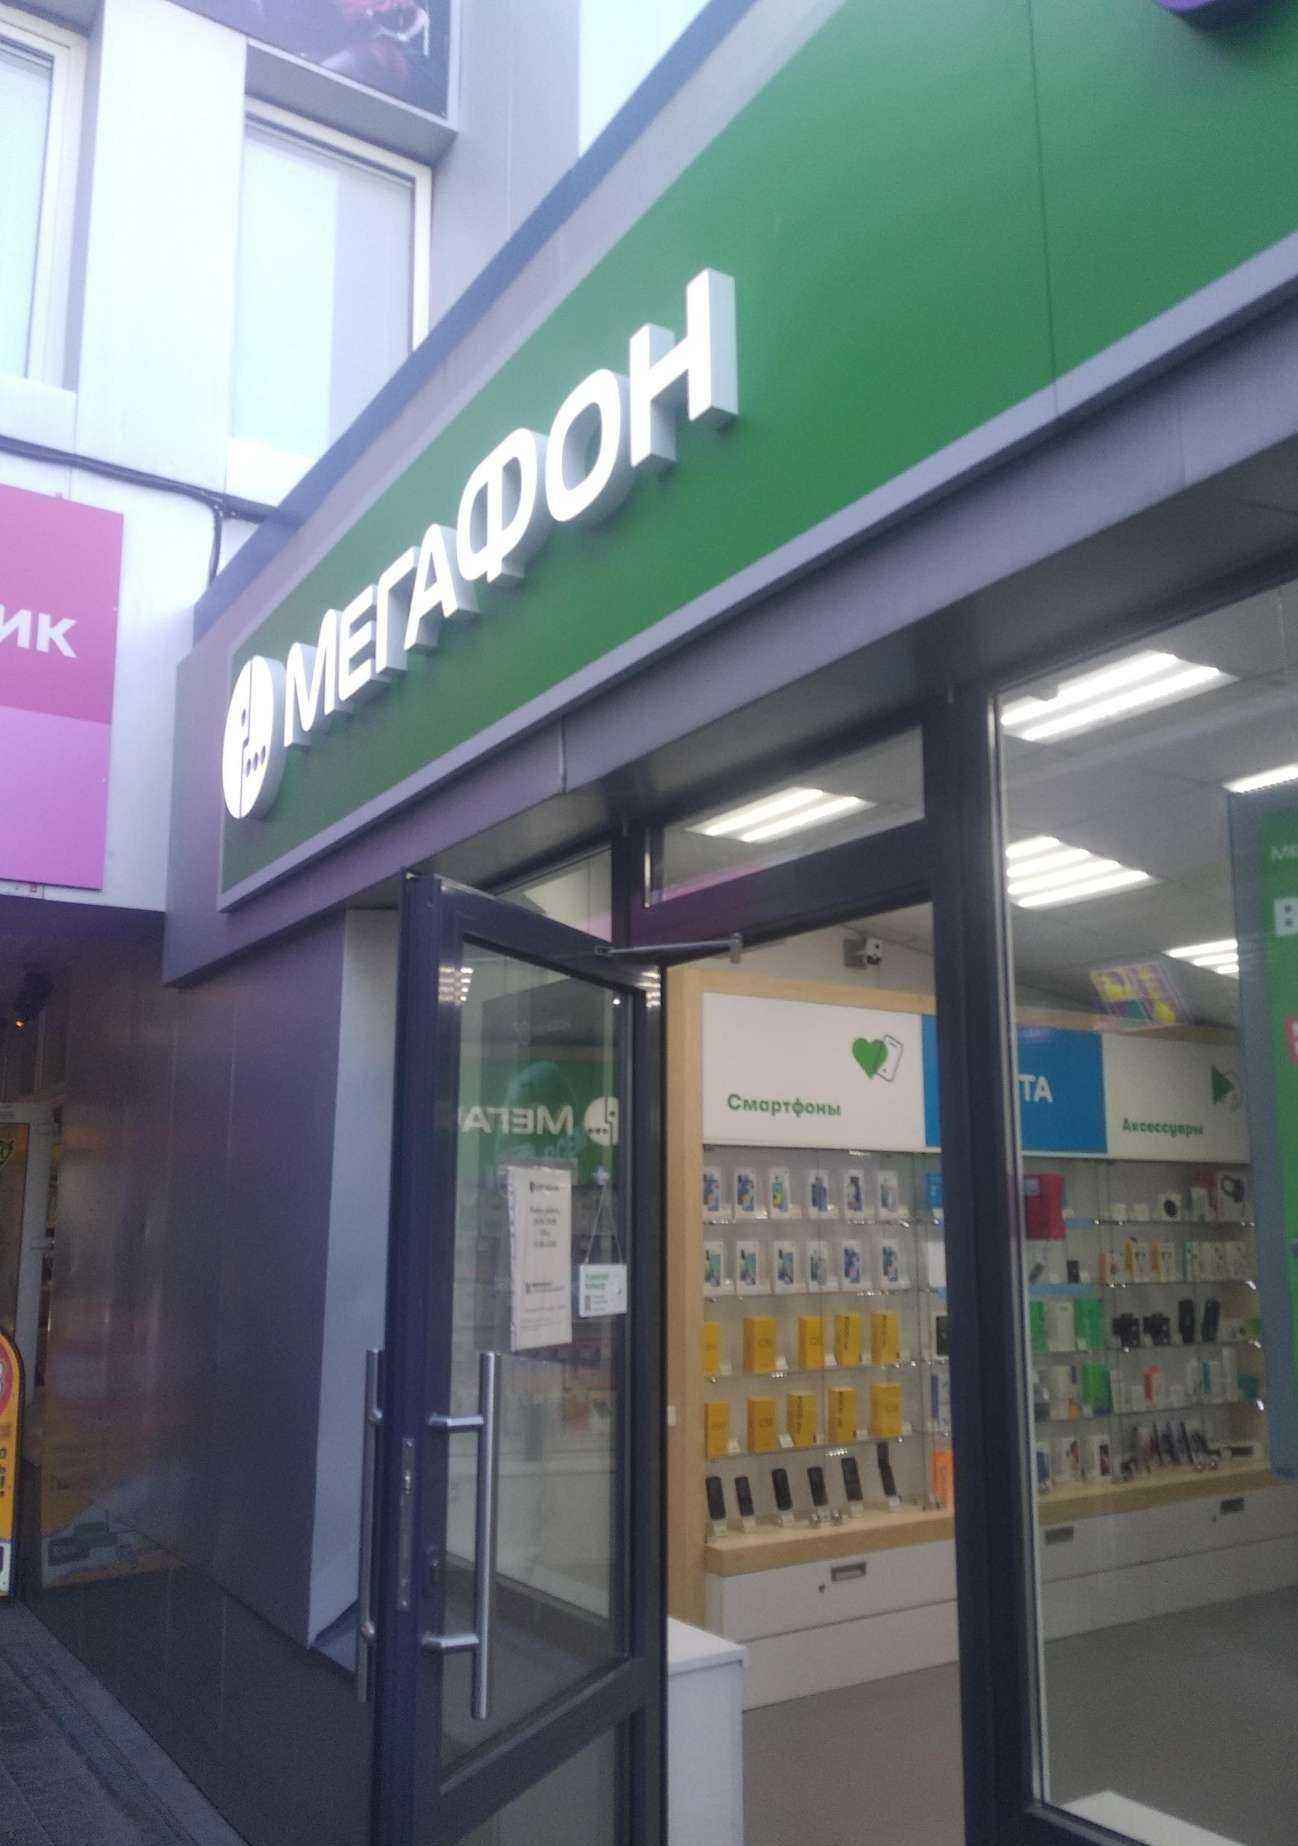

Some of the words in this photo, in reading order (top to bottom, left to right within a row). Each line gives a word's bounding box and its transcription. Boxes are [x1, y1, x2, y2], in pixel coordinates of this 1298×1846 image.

[284, 268, 738, 748] МЕГАФОН
[727, 1093, 842, 1117] Смартфоны
[1122, 1118, 1204, 1138] Аксессуары
